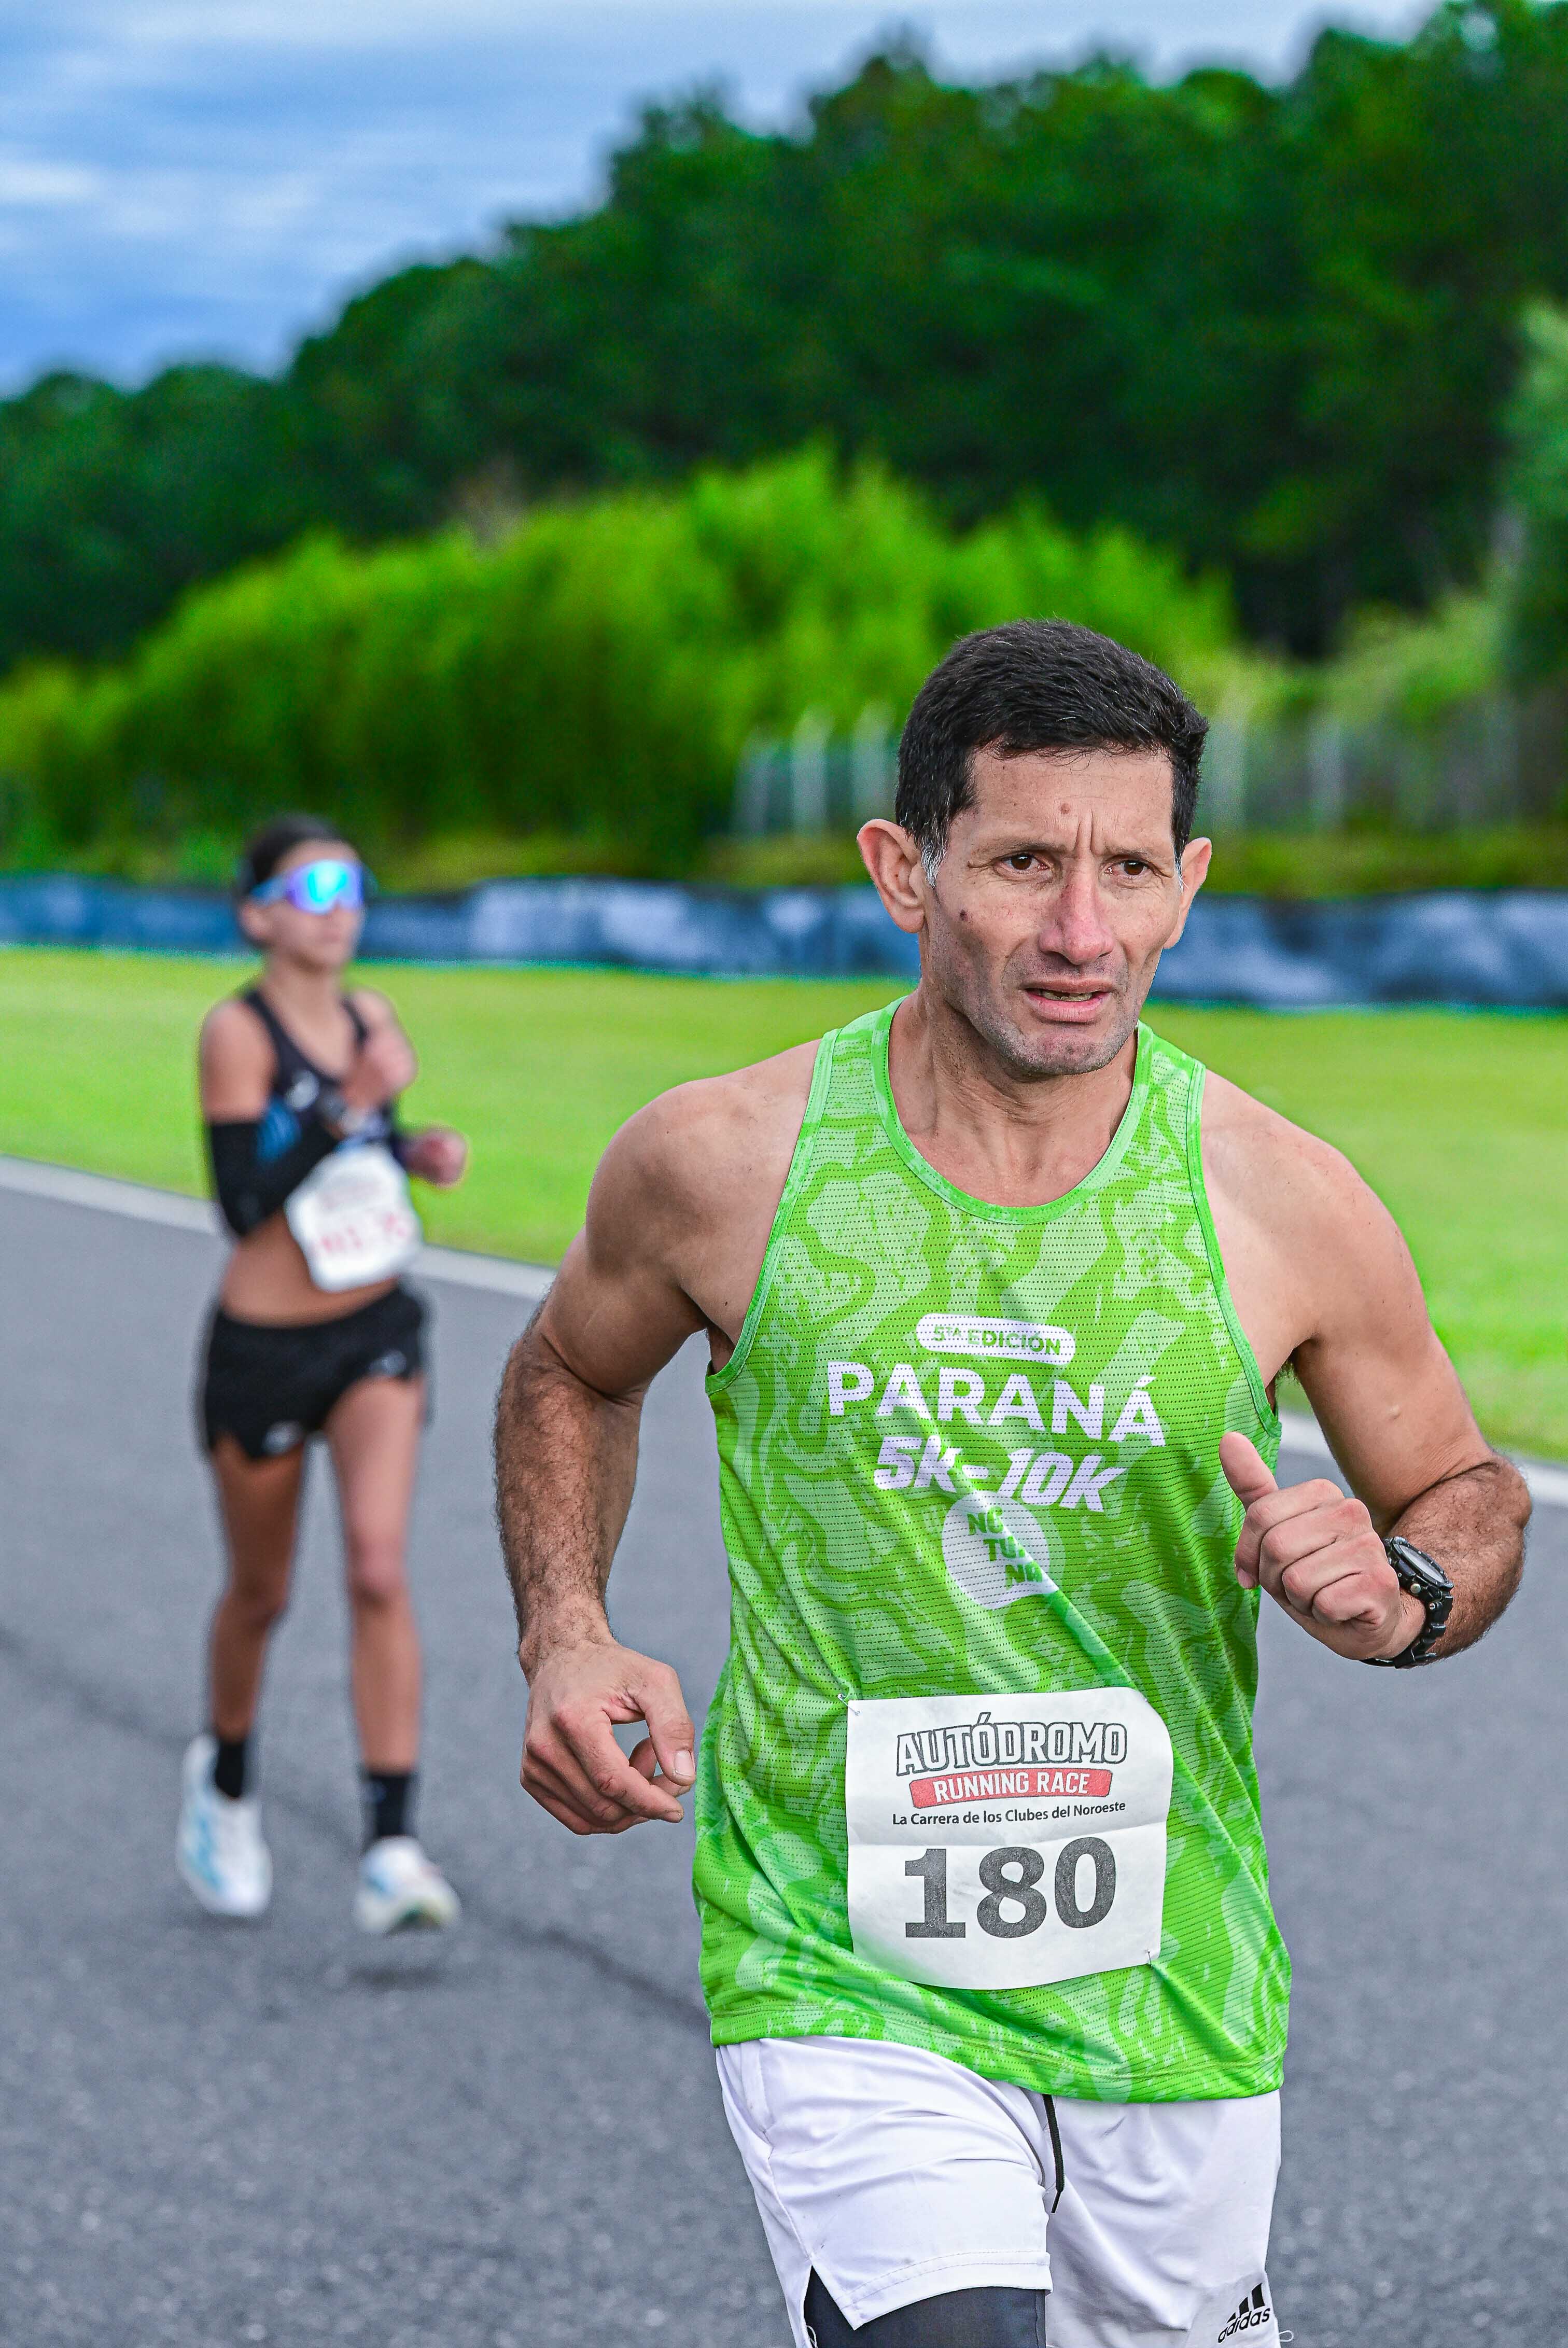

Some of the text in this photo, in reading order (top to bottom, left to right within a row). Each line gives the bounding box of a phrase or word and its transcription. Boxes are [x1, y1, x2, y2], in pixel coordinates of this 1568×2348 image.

[967, 1329, 1061, 1355] EDICIÓN
[827, 1361, 1166, 1447] PARANÁ
[897, 1712, 1127, 1777] AUTÓDROMO
[933, 1772, 1090, 1804] RUNNING RACE
[892, 1801, 1126, 1825] La Carrera de los Clubes del Noroeste
[905, 1837, 1116, 1938] 180
[1217, 2308, 1270, 2343] adidas
